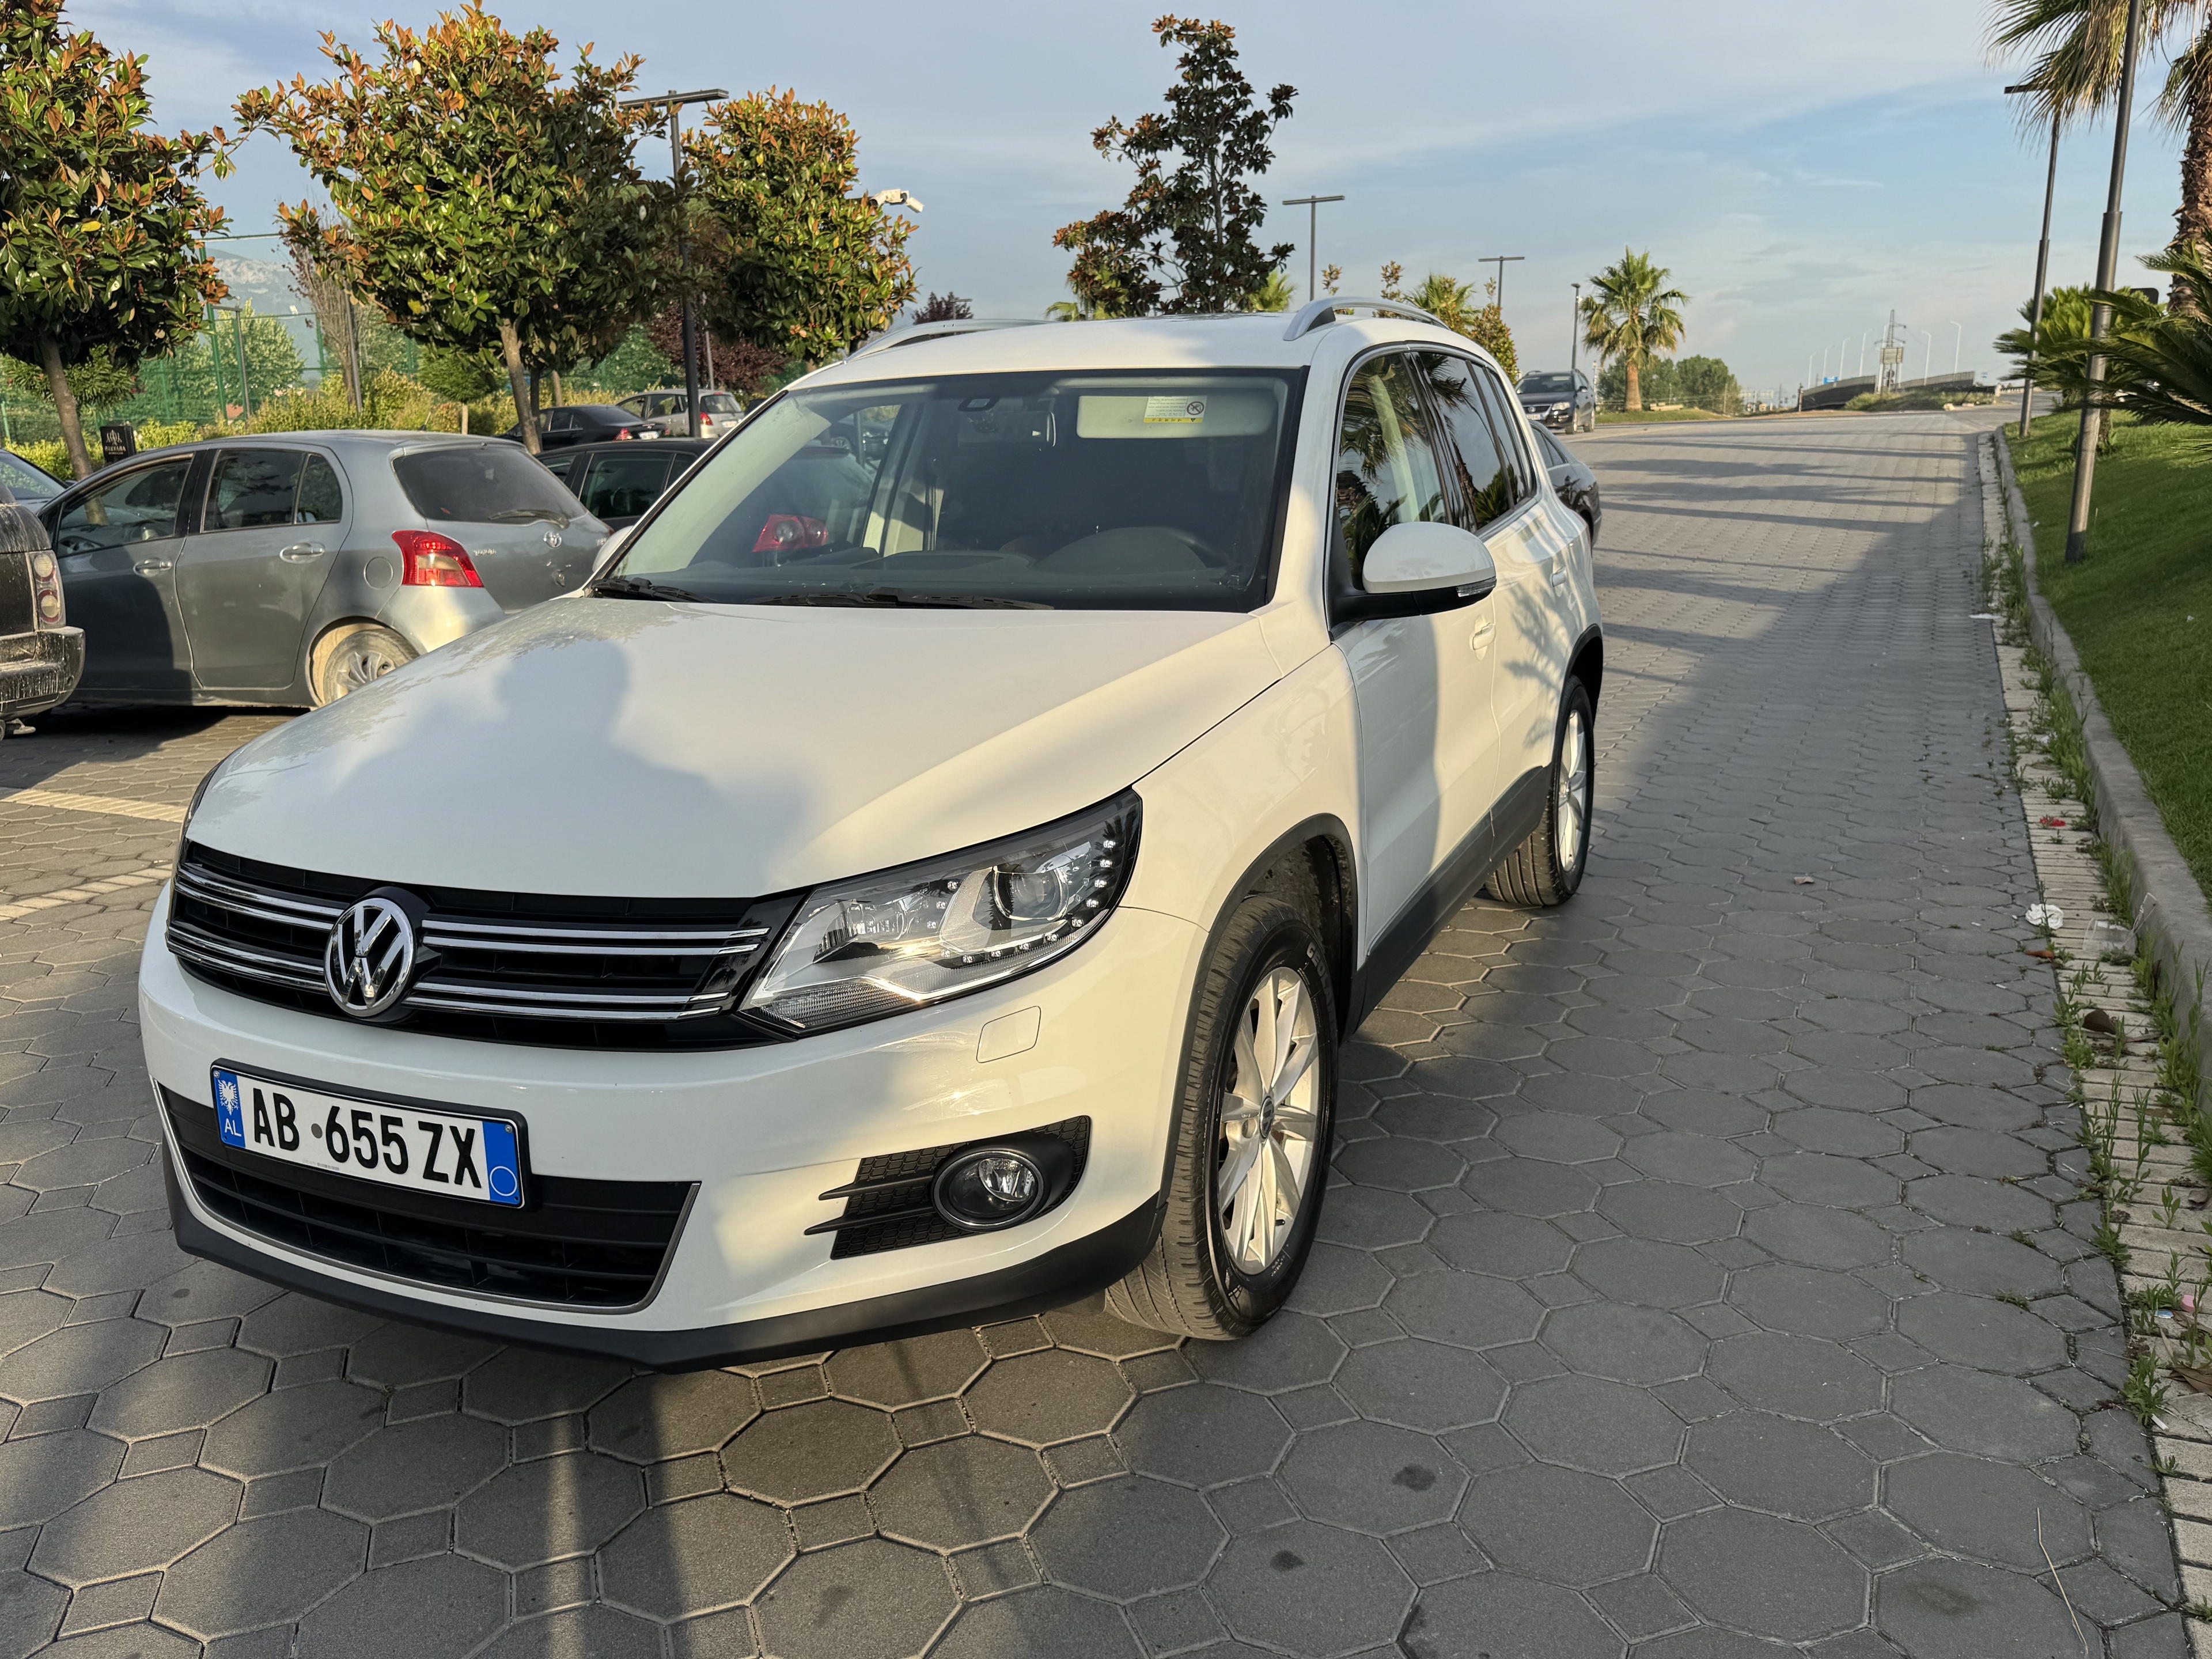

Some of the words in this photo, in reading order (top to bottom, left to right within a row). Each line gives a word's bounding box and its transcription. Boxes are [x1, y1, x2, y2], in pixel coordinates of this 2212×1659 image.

[326, 900, 412, 1016] VW
[224, 1118, 242, 1138] AL
[253, 1088, 300, 1152] AB
[325, 1105, 409, 1175] 655
[418, 1120, 482, 1188] ZX
